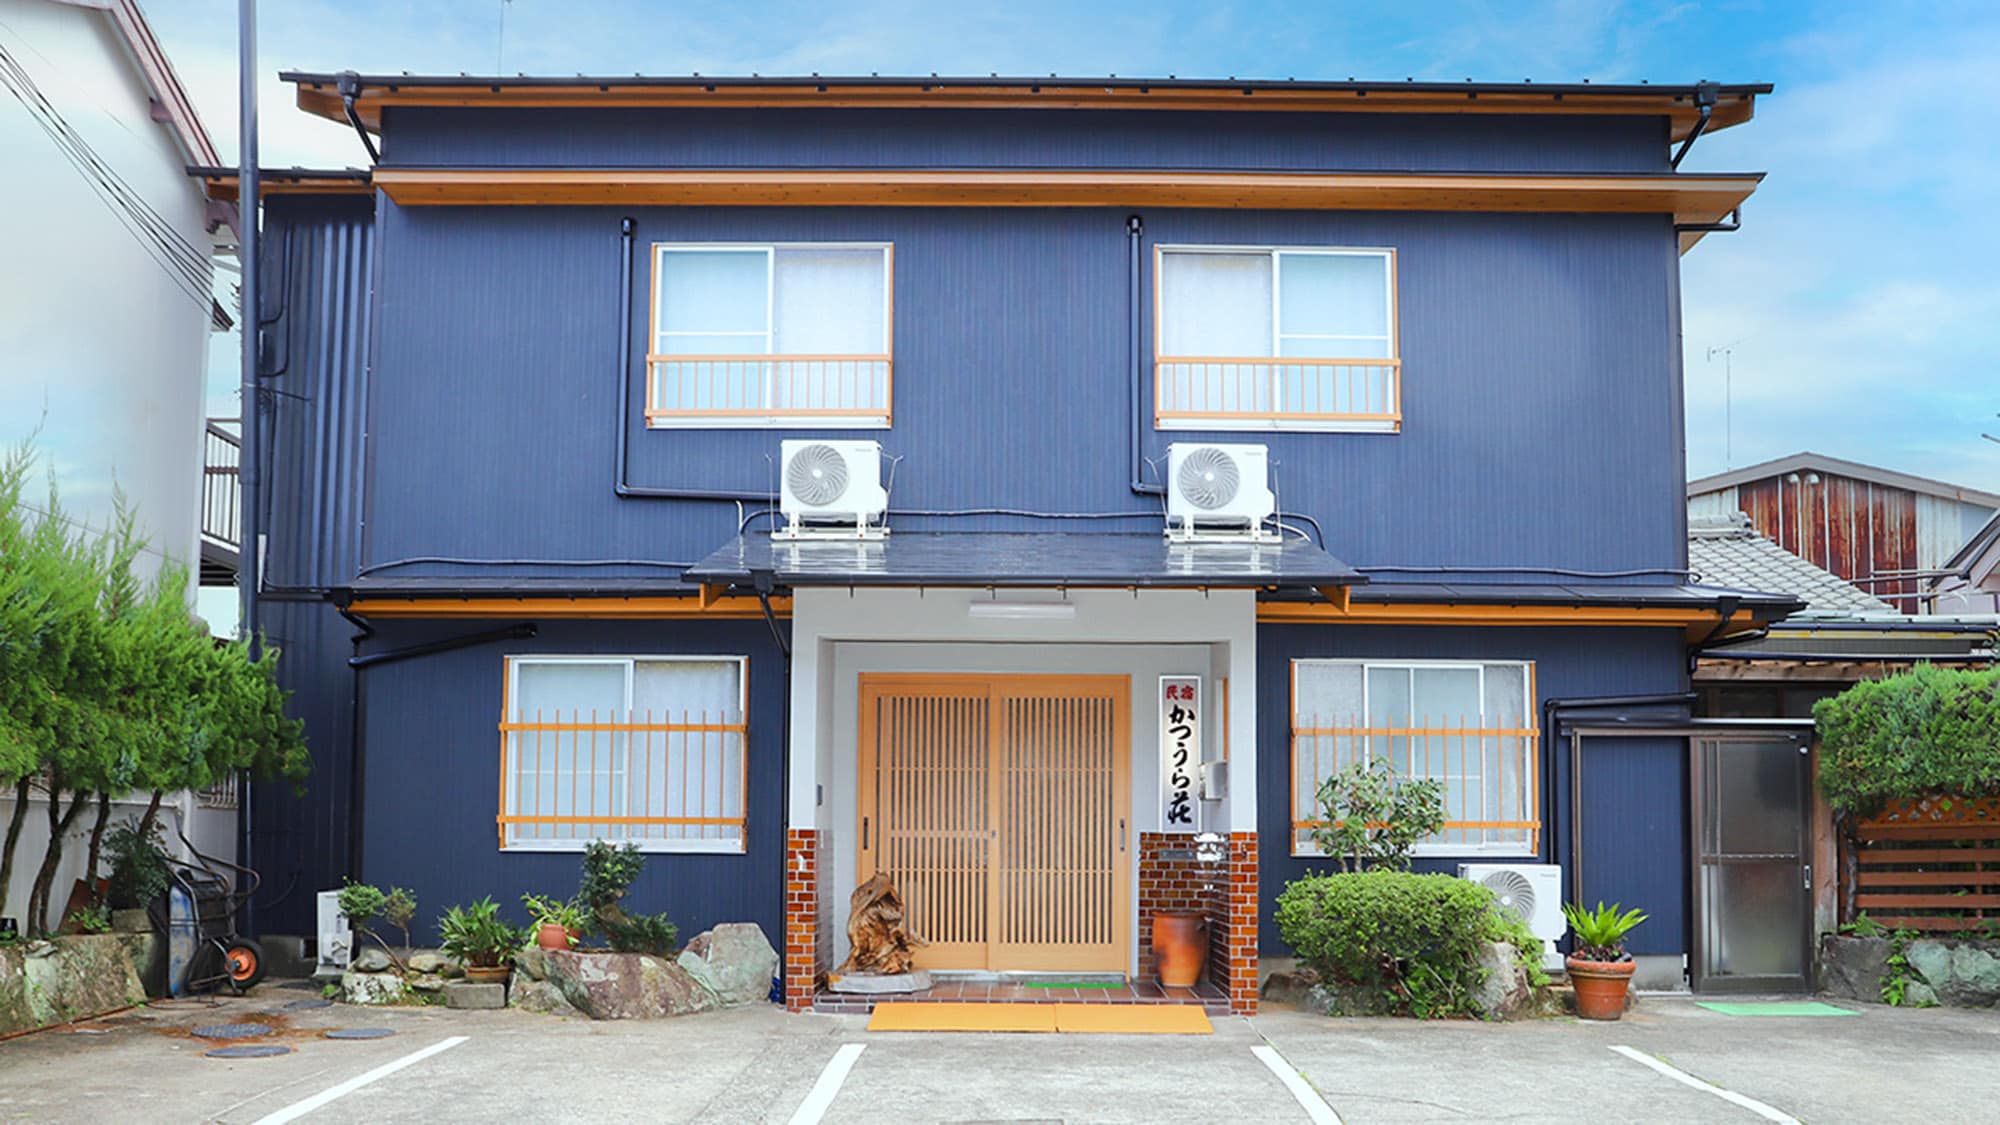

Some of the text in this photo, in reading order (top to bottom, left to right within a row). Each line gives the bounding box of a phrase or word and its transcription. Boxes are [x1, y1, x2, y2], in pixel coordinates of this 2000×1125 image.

[1166, 685, 1195, 700] 民宿
[1168, 704, 1196, 824] かつうら荘
